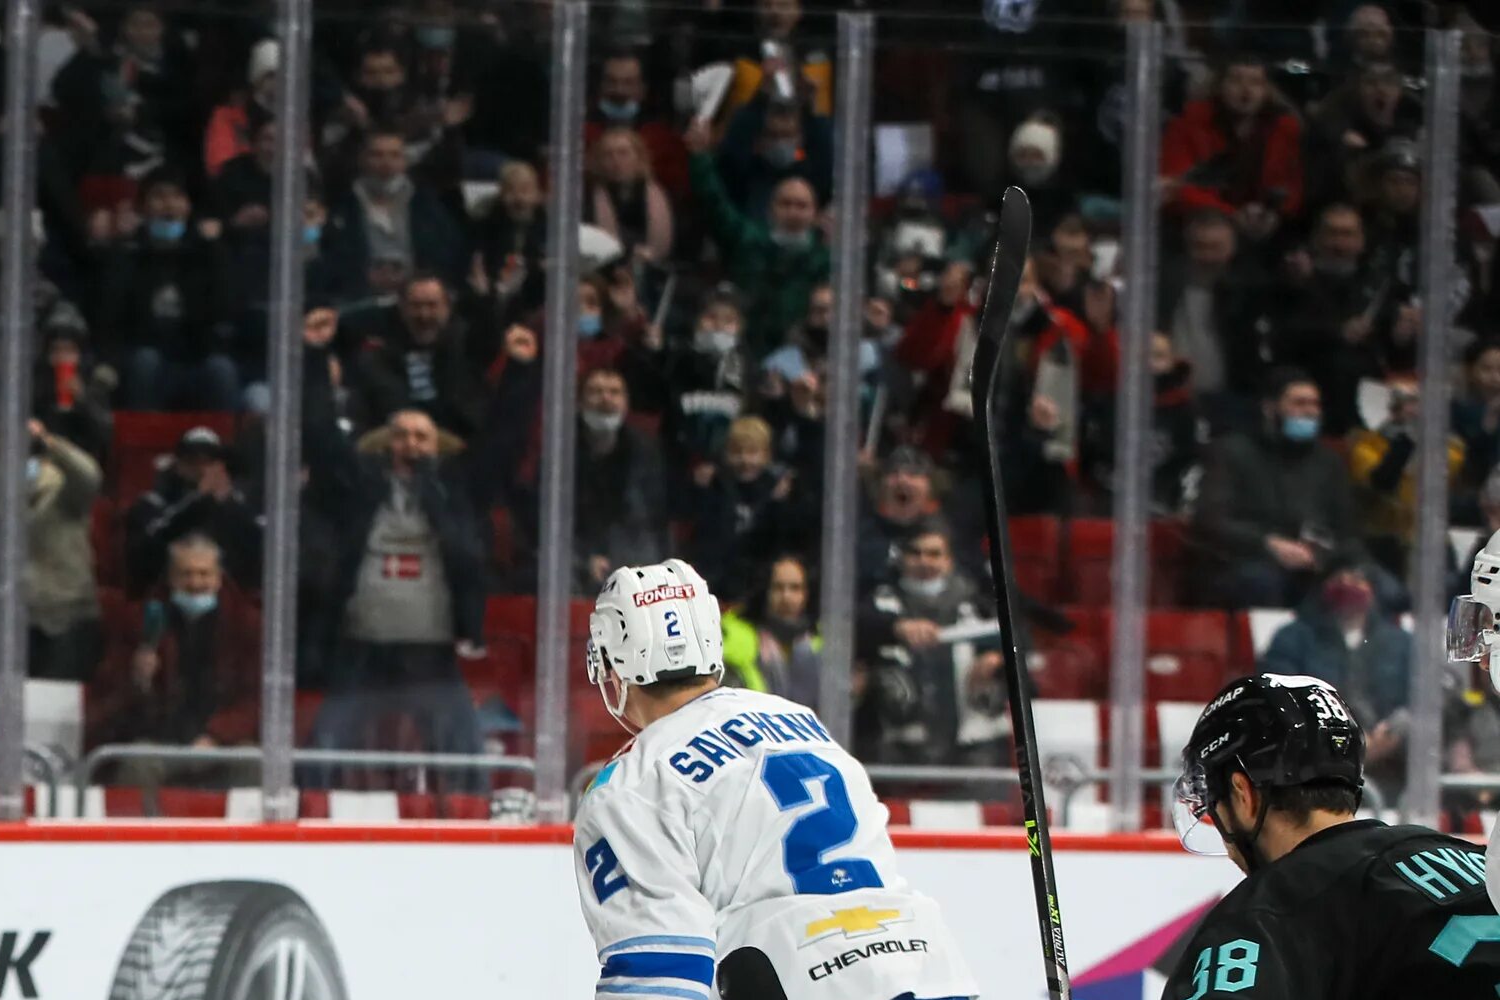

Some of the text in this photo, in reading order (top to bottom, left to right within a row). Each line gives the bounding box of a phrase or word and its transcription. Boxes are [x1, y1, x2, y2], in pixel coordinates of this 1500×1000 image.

[634, 585, 694, 607] FONBET
[664, 611, 681, 637] 2
[1307, 689, 1350, 722] 38
[1200, 732, 1230, 759] CCM
[760, 749, 886, 896] 2
[584, 836, 630, 905] 2
[808, 939, 928, 981] CHEVROLET
